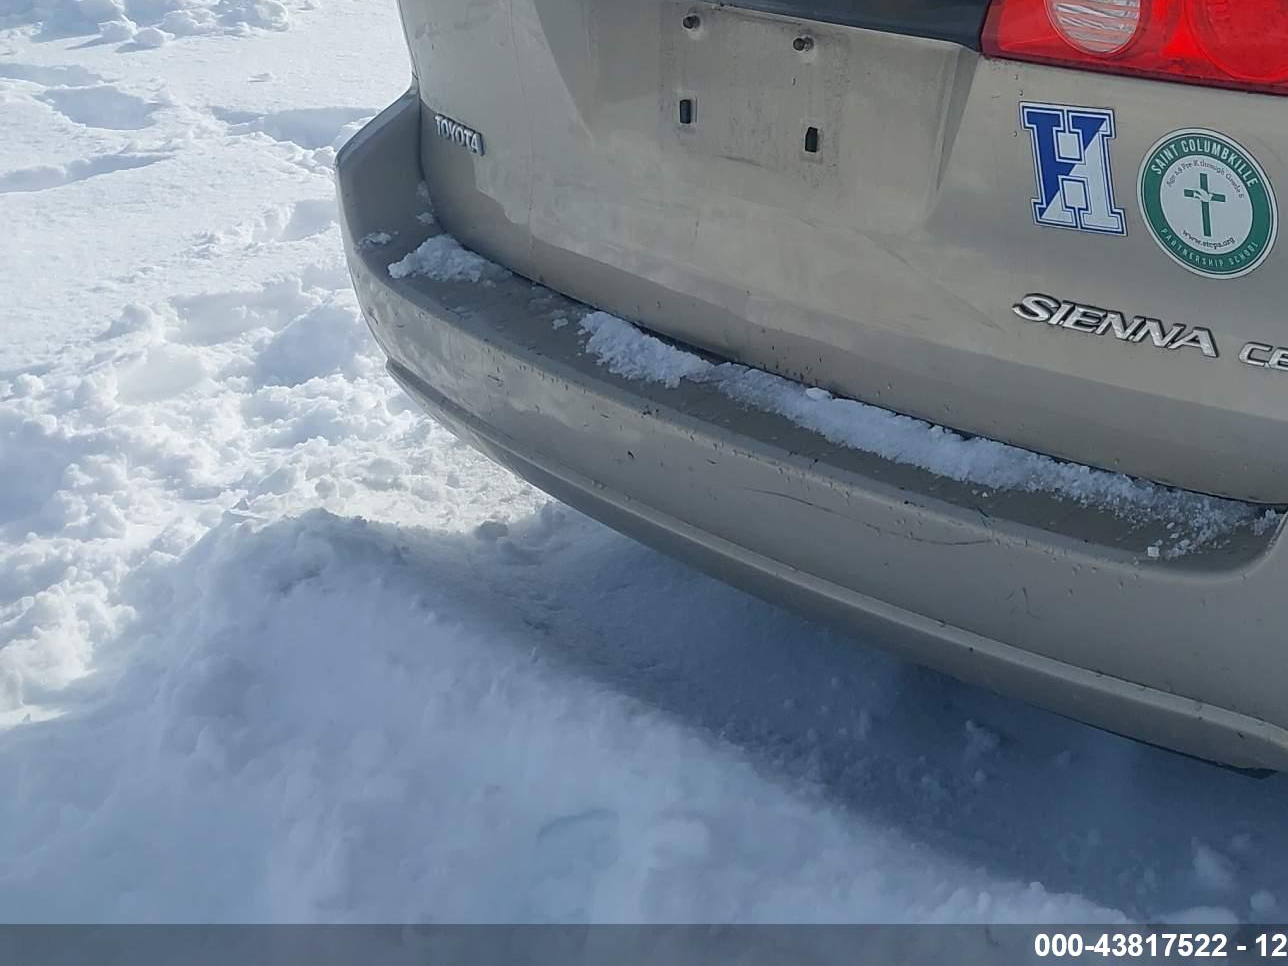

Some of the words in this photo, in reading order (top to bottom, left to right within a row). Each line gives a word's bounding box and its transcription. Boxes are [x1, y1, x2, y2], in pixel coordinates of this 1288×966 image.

[434, 114, 485, 156] TOYOTA
[1151, 144, 1179, 174] SAINT
[1181, 139, 1258, 187] COLUMBKILLE
[1160, 227, 1224, 267] PARTNERSHIP
[1228, 241, 1259, 266] SCHOOL
[1012, 292, 1219, 358] SIENNA
